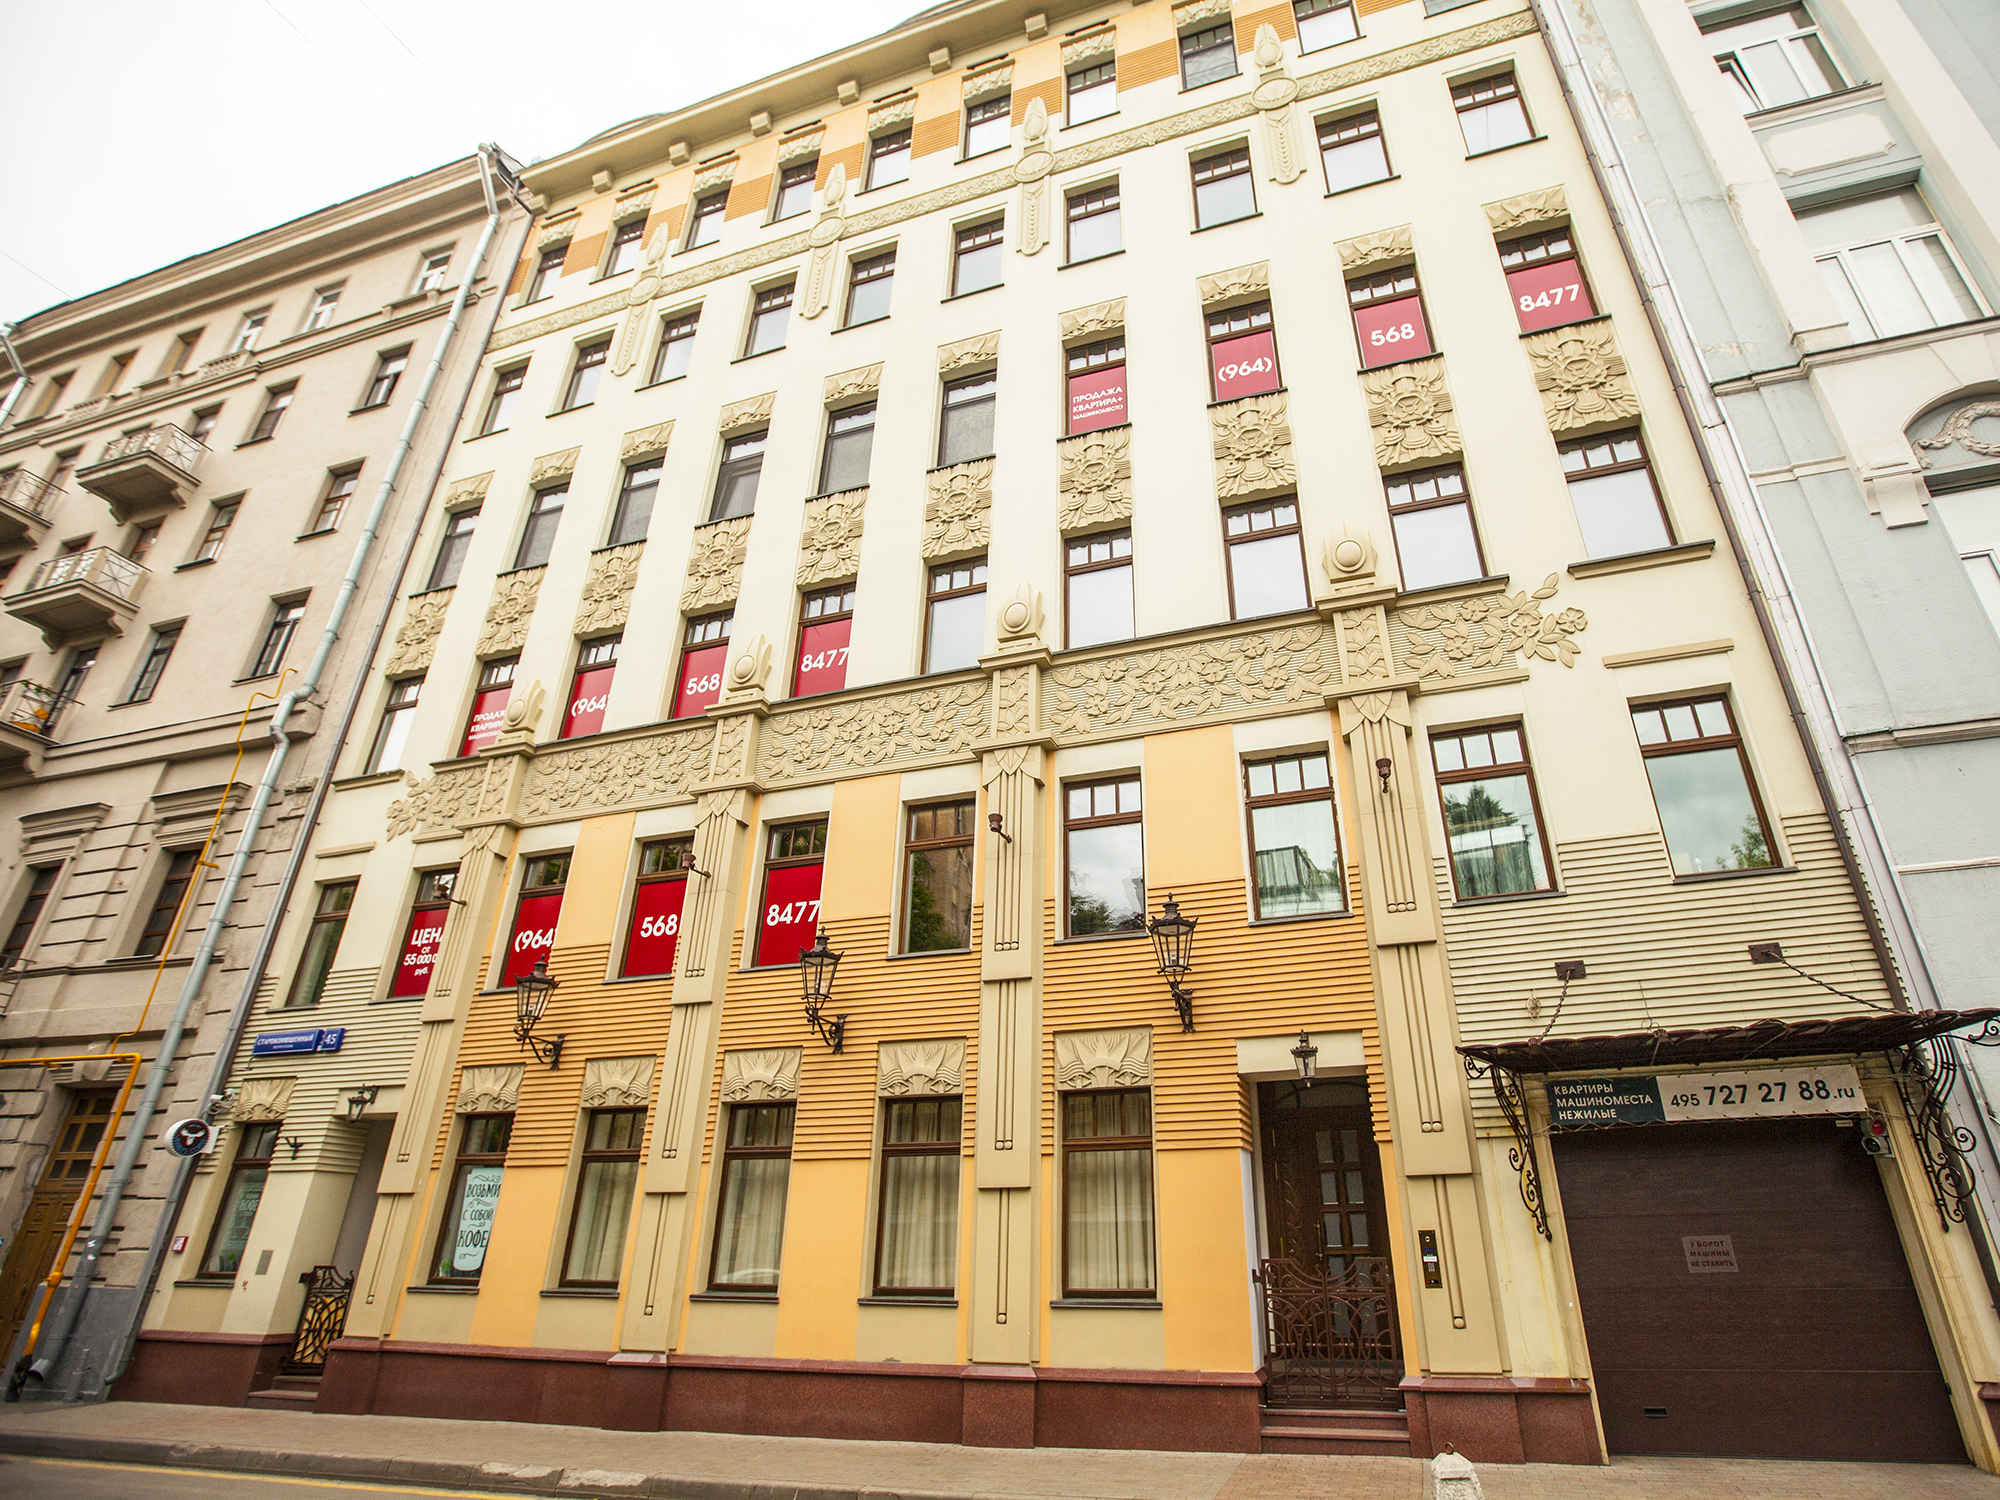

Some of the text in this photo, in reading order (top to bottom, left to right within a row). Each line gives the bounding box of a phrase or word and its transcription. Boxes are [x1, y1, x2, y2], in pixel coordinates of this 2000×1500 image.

[1519, 284, 1579, 312] 8477
[1371, 323, 1415, 346] 568
[1218, 357, 1272, 382] (964)
[1073, 386, 1123, 404] ПРОДАЖА
[1073, 396, 1124, 413] КВАРТИРА+
[1073, 404, 1124, 420] МАШИНОМЕСТО
[801, 647, 850, 672] 8477
[685, 673, 720, 695] 568
[766, 900, 820, 927] 8477
[640, 914, 678, 938] 568
[515, 928, 558, 953] (964
[324, 1033, 338, 1045] 45
[1554, 1084, 1613, 1095] КВАРТИРЫ
[1671, 1093, 1700, 1107] 495
[1703, 1084, 1748, 1105] 727
[1758, 1082, 1787, 1103] 27
[1556, 1095, 1653, 1107] МАШИНОМЕСТА
[1559, 1109, 1617, 1120] НЕЖИЛЫЕ
[465, 1183, 502, 1198] ВОЗЬМИ
[470, 1207, 495, 1221] СОБОЙ
[456, 1229, 489, 1249] КОФЕ
